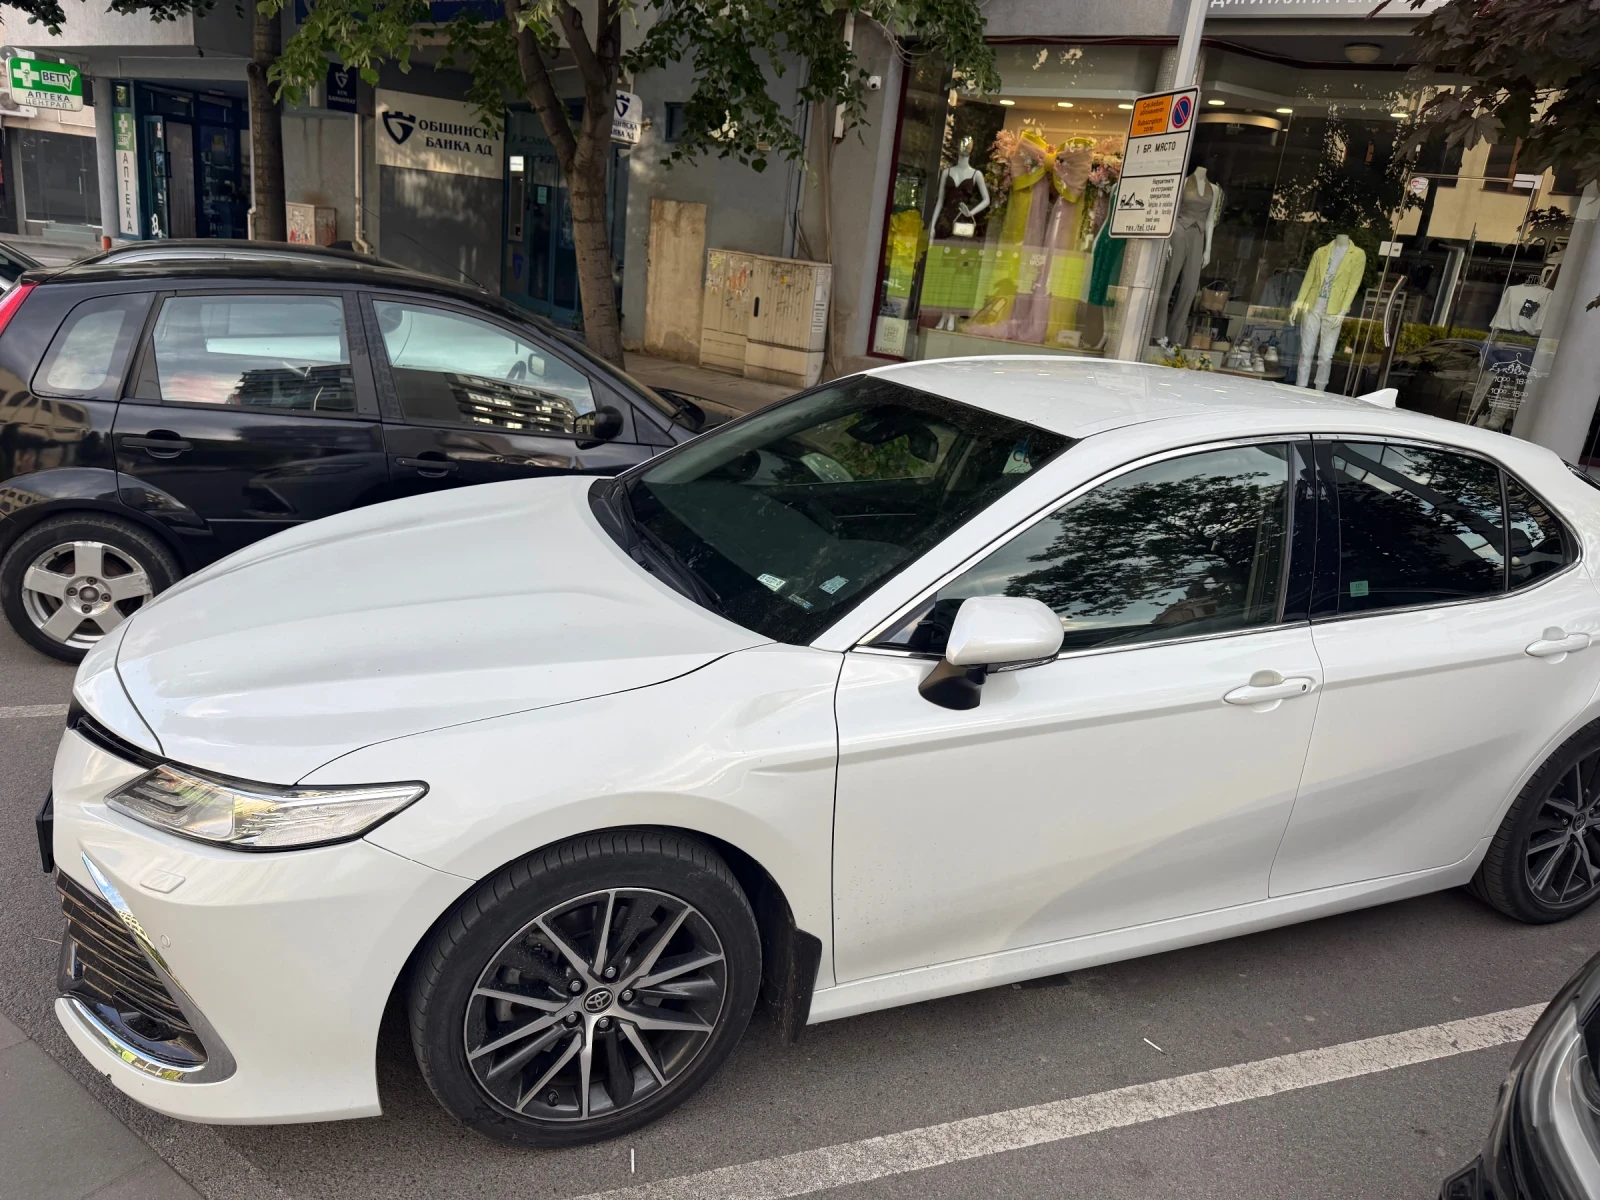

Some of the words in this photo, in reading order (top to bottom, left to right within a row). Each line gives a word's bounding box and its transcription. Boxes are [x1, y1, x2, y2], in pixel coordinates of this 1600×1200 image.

[42, 71, 73, 90] BETTY
[25, 98, 67, 109] ЦЕНТРАЛ
[27, 91, 70, 102] АПТЕКА
[418, 119, 500, 141] ОБЩИНСКА
[426, 136, 471, 153] БАНКА
[475, 143, 493, 157] АД
[1136, 144, 1140, 154] 1
[1143, 143, 1152, 154] БР.
[1154, 140, 1177, 153] МЯСТО
[122, 151, 133, 232] АПТЕКА
